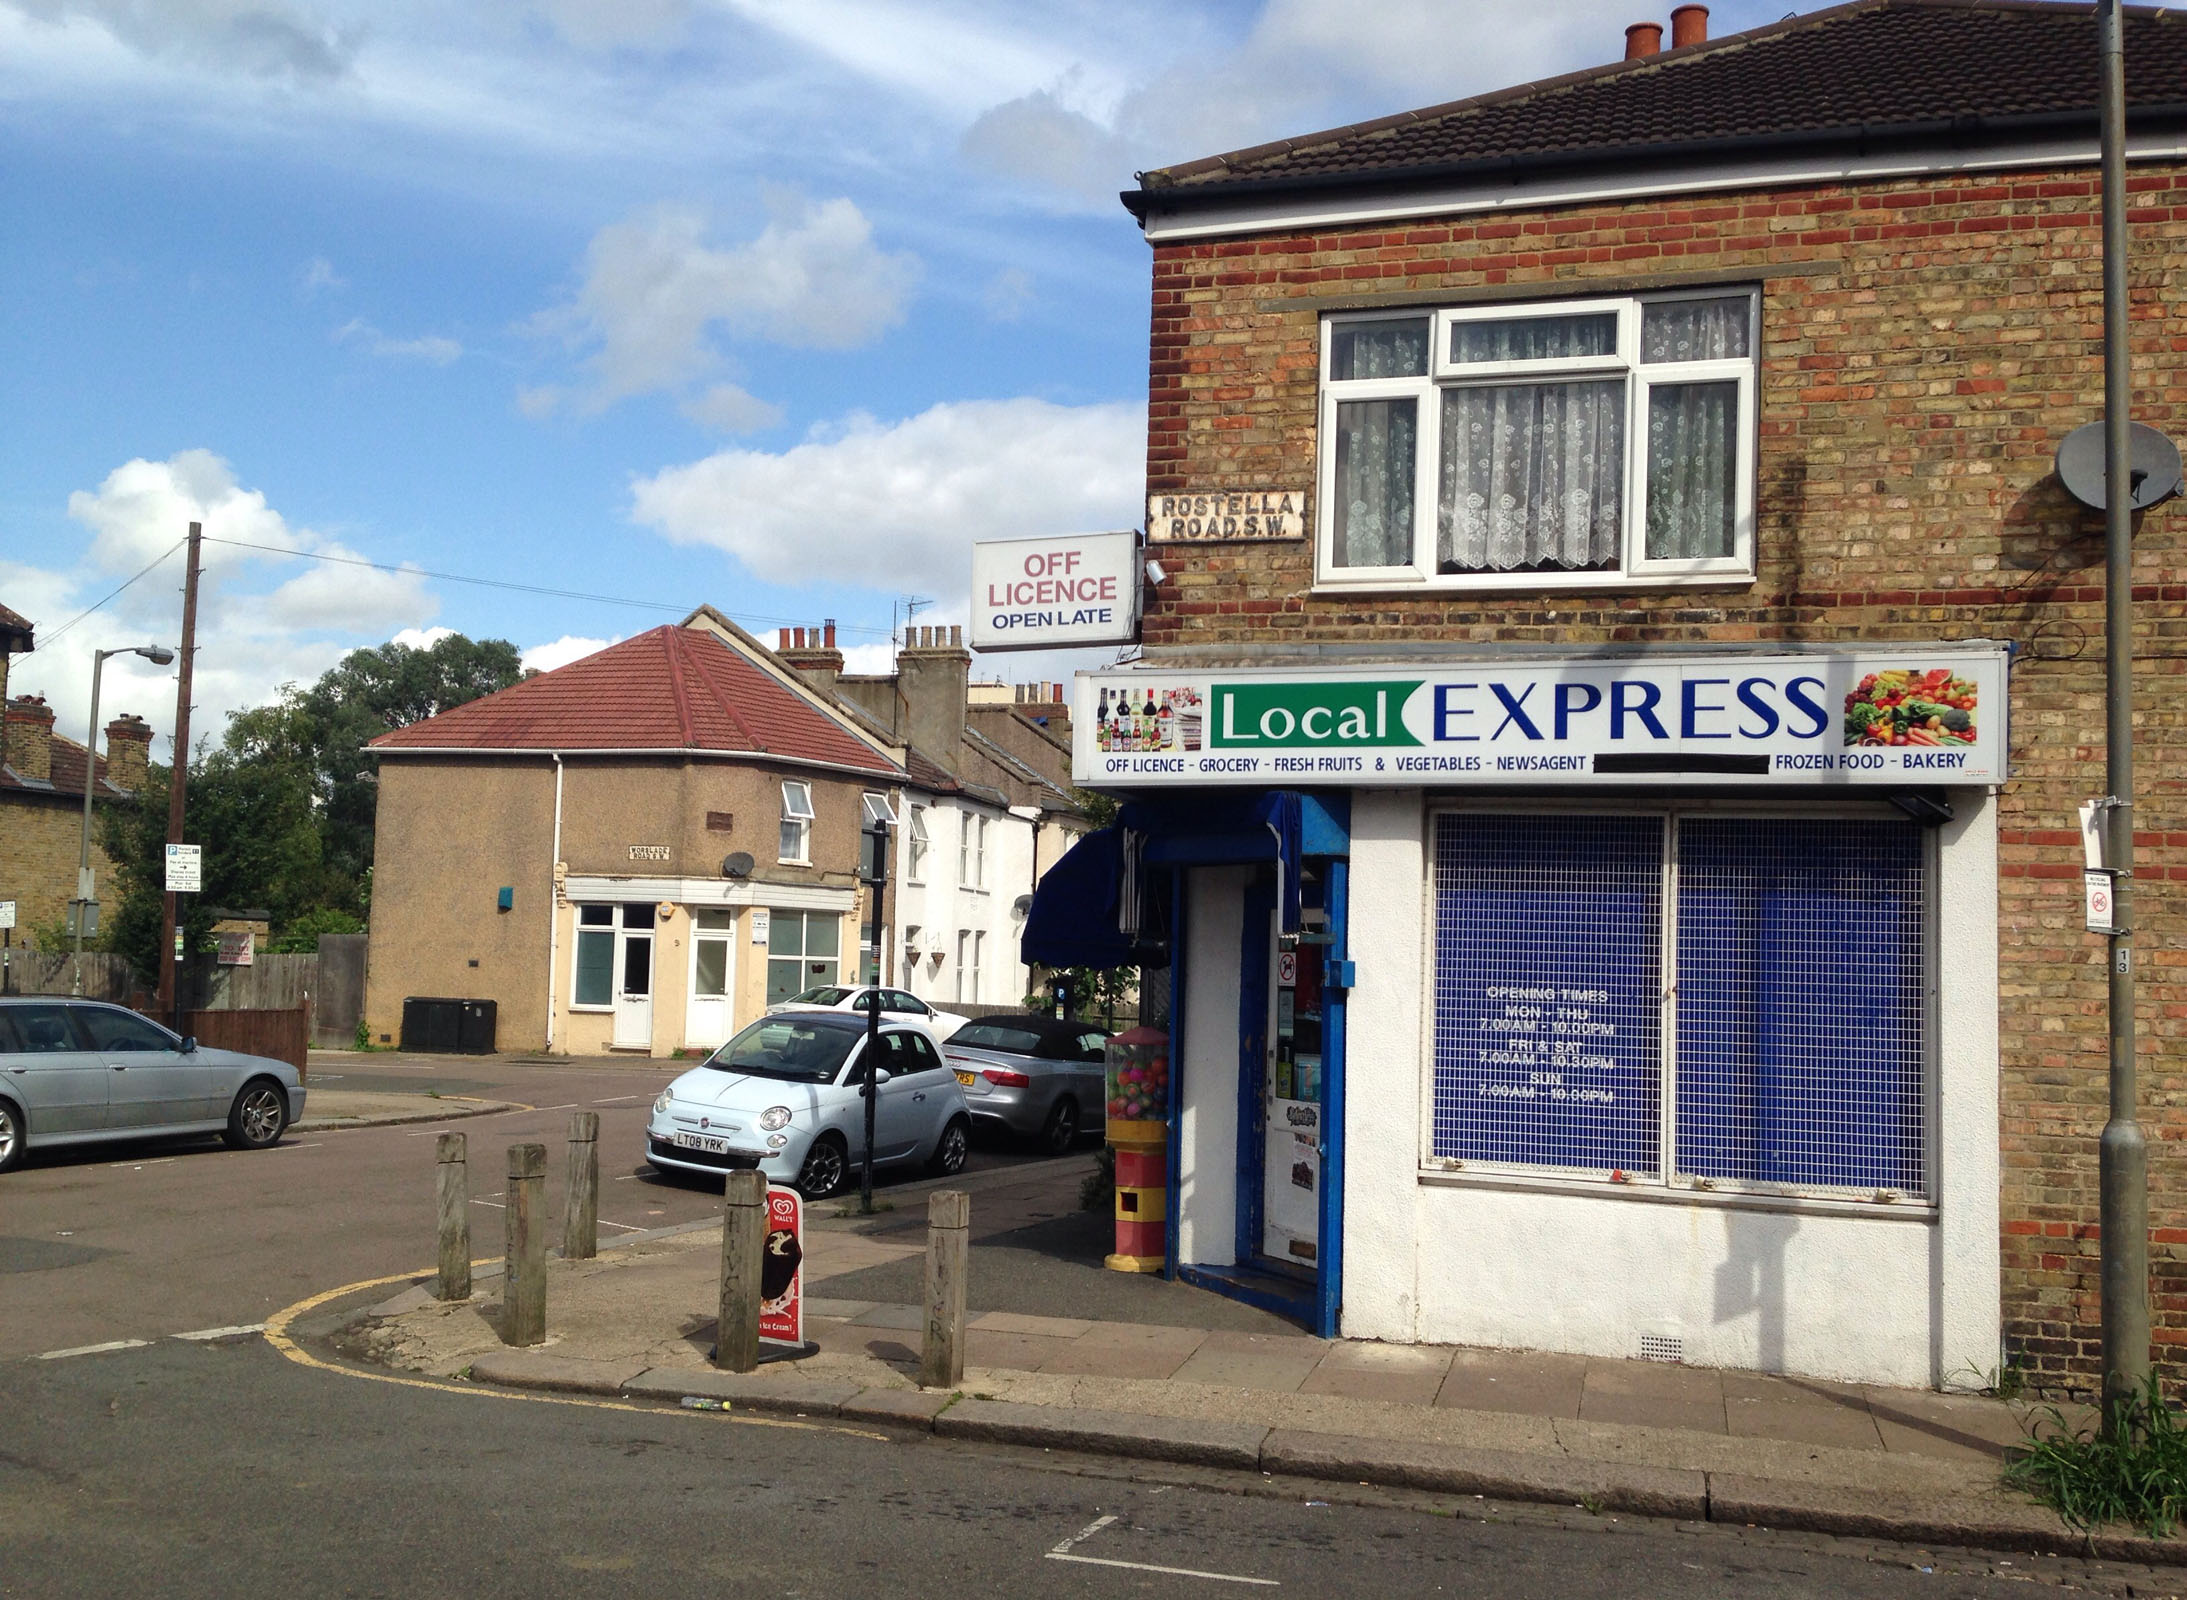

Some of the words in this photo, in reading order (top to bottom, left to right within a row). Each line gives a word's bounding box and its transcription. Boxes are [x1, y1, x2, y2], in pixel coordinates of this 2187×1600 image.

[1162, 492, 1294, 517] ROSTELLA
[1023, 551, 1082, 578] OFF
[988, 576, 1117, 608] LICENCE
[992, 611, 1053, 630] OPEN
[1057, 608, 1112, 626] LATE
[1222, 690, 1387, 741] Local
[1433, 676, 1830, 742] EXPRESS
[1105, 758, 1129, 773] OFF
[1133, 758, 1185, 773] LICENCE
[1199, 758, 1260, 772] GROCERY
[1274, 757, 1314, 772] FRESH
[1318, 756, 1363, 772] FRUITS
[1375, 757, 1386, 771] &
[1395, 755, 1481, 771] VEGETABLES
[1496, 755, 1587, 770] NEWSAGENT
[1775, 753, 1835, 770] FROZEN
[1838, 753, 1885, 770] FOOD
[1902, 752, 1967, 769] BAKERY
[1487, 986, 1556, 1001] OPENING
[1561, 989, 1608, 1003] TIMES
[1505, 1005, 1541, 1018] MON
[1557, 1008, 1588, 1020] THU
[1480, 1017, 1535, 1032] 7.00AM
[1552, 1021, 1615, 1036] 10.00PM
[1509, 1039, 1532, 1051] FRI
[1554, 1042, 1583, 1054] SAT
[1479, 1051, 1535, 1066] 7.00AM
[1551, 1055, 1615, 1070] 10.30PM
[1530, 1072, 1561, 1085] SUN
[1479, 1084, 1535, 1099] 7.00AM
[677, 1133, 702, 1148] LT08
[704, 1137, 723, 1152] YRK
